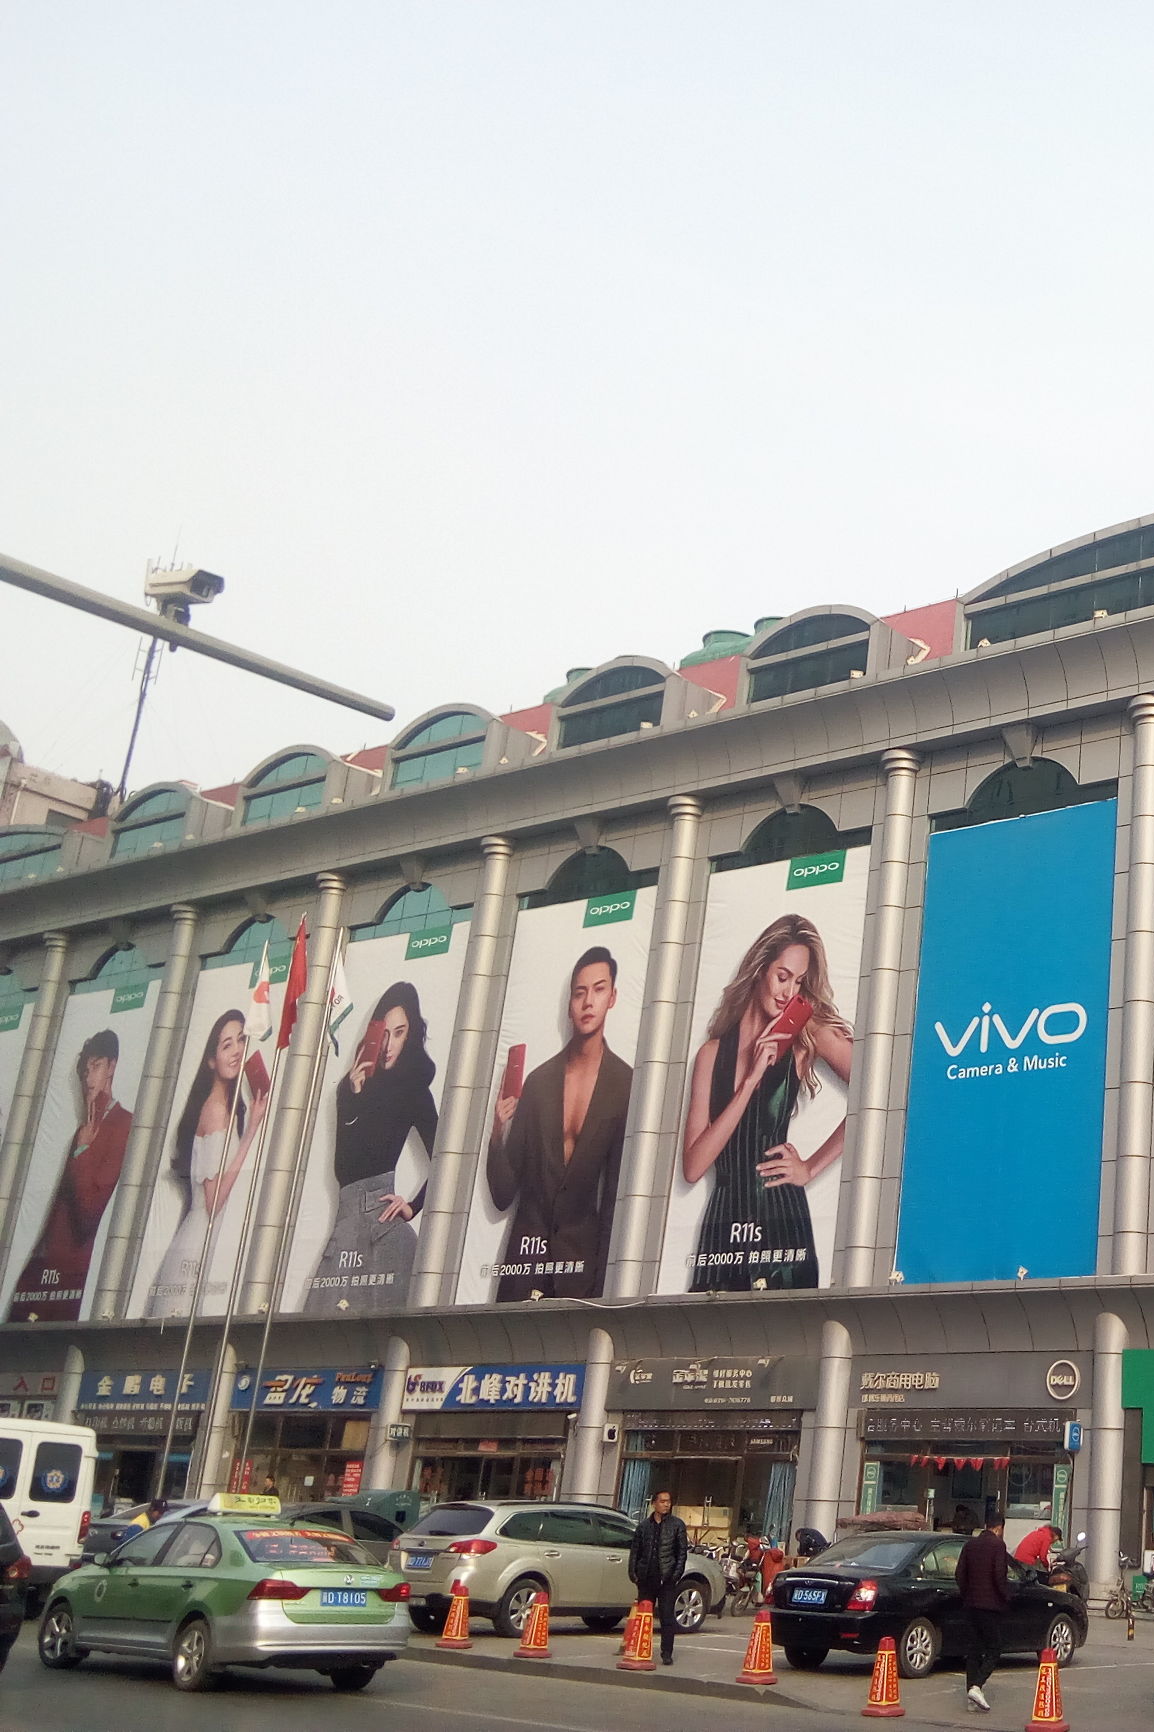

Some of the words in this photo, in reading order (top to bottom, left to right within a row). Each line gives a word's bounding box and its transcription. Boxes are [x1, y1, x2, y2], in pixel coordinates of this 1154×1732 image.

[793, 861, 839, 879] oppo
[589, 900, 631, 917] oppo
[411, 937, 446, 949] oppo
[116, 989, 144, 1003] oppo
[934, 1001, 1088, 1058] vivo
[946, 1063, 1003, 1080] Camera
[1007, 1057, 1018, 1073] &
[1023, 1052, 1067, 1070] Music
[729, 1221, 762, 1244] R11s
[520, 1236, 548, 1256] R11s
[339, 1250, 364, 1269] R11s
[686, 1251, 745, 1268] 前后2000万
[455, 1371, 577, 1405] 北峰对讲机
[1050, 1376, 1075, 1386] DELL
[331, 1386, 369, 1405] 物流
